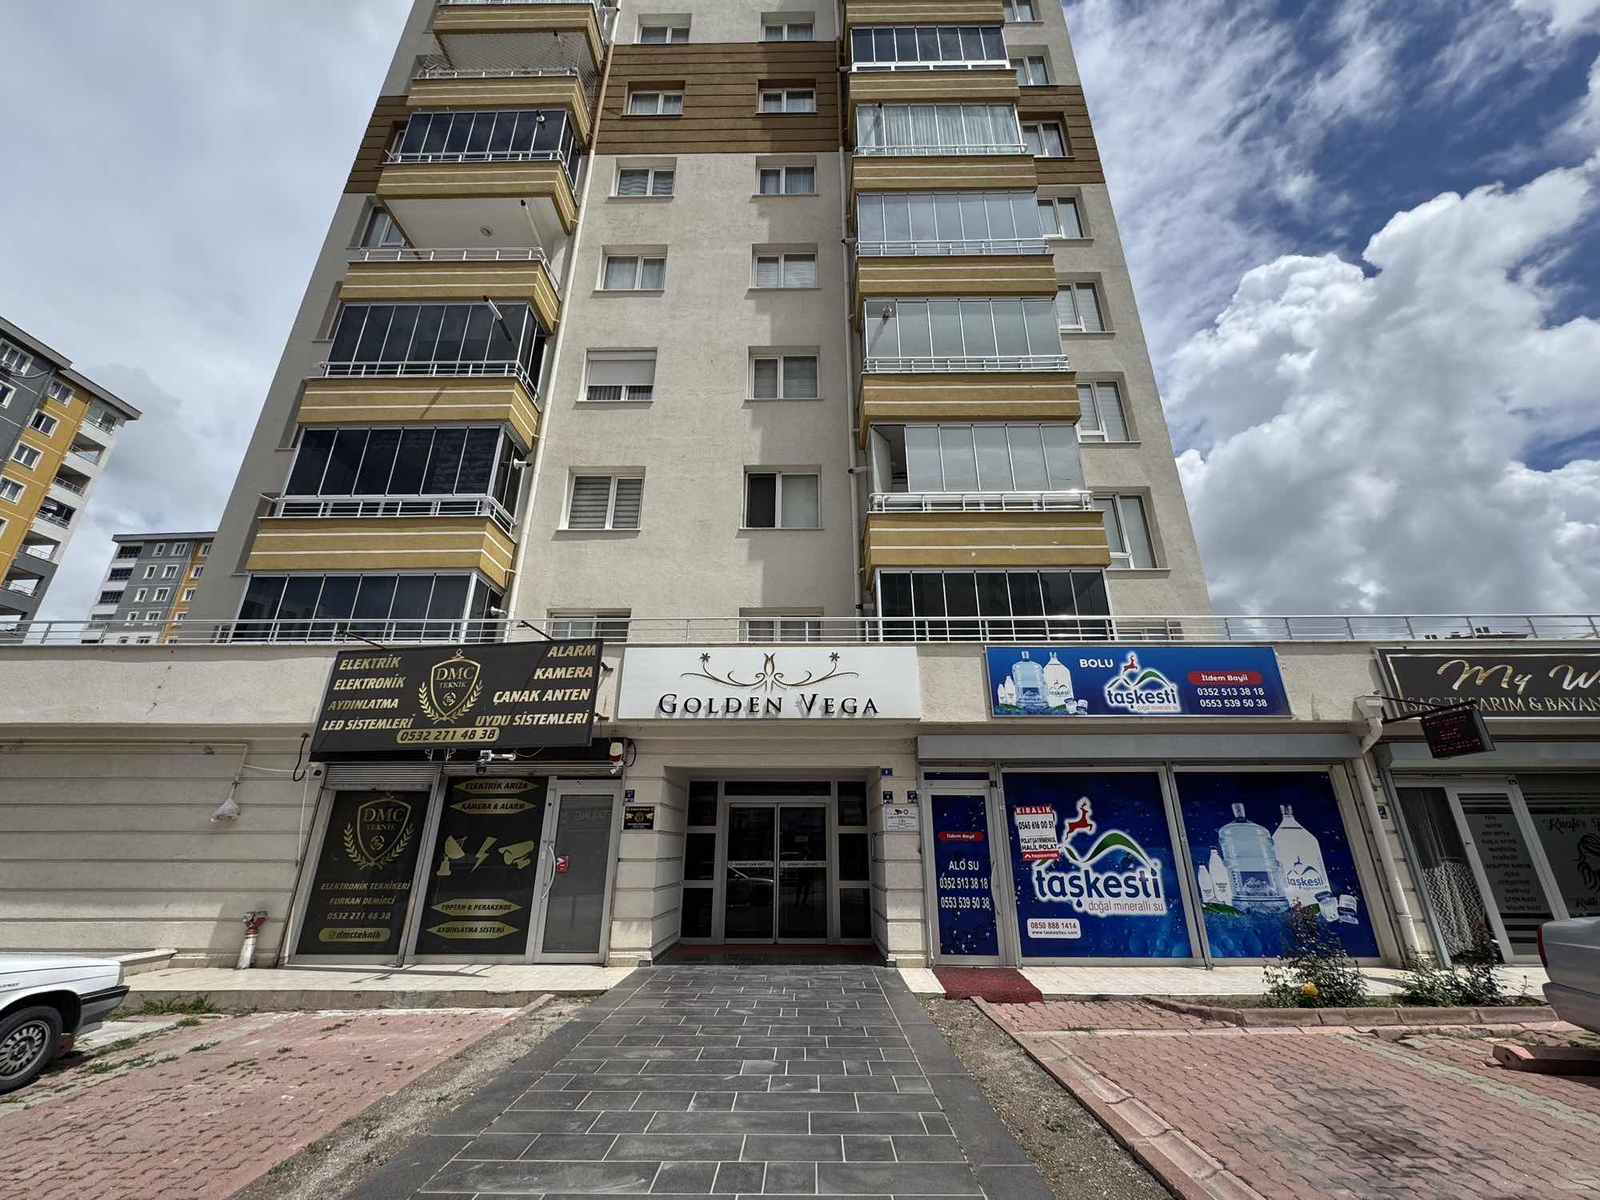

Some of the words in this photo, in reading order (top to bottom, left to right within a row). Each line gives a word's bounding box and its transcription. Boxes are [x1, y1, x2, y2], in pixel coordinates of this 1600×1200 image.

[547, 644, 597, 657] ALARM
[339, 654, 402, 671] ELEKTRİK
[1080, 659, 1114, 668] BOLU
[434, 666, 475, 681] DMC
[533, 666, 594, 679] KAMERA
[1548, 664, 1600, 691] W
[333, 674, 407, 690] ELEKTRONİK
[493, 690, 540, 705] ÇANAK
[542, 688, 591, 702] ANTEN
[1197, 687, 1219, 696] 0352
[1221, 687, 1238, 696] 513
[1239, 688, 1251, 696] 38
[1255, 688, 1264, 696] 18
[327, 698, 399, 711] AYDINLATMA
[658, 694, 783, 714] GOLDEN
[800, 694, 879, 714] VEGA
[1200, 699, 1222, 708] 0553
[1224, 699, 1241, 708] 539
[1242, 699, 1254, 708] 50
[1256, 699, 1267, 708] 38
[1529, 697, 1544, 711] &
[321, 719, 346, 731] LED
[347, 714, 416, 731] SİSTEMLERİ
[475, 714, 510, 727] UYDU
[512, 709, 590, 727] SİSTEMLERİ
[400, 730, 430, 742] 0532
[433, 730, 457, 742] 271
[460, 729, 477, 741] 48
[479, 729, 497, 741] 38
[465, 780, 503, 790] ELEKTRİK
[504, 782, 529, 790] ARIZA
[461, 802, 491, 810] KAMERA
[500, 802, 525, 810] ALARM
[1016, 806, 1051, 814] KIRALIK
[363, 807, 405, 822] DMC
[967, 860, 979, 871] SU
[320, 880, 367, 890] ELEKTRONİK
[369, 880, 411, 890] TEKNİKERİ
[939, 877, 955, 889] 0352
[956, 877, 969, 889] 513
[970, 877, 979, 889] 38
[980, 877, 988, 889] 18
[329, 897, 362, 905] FURKAN
[940, 897, 957, 909] 0553
[958, 897, 970, 909] 539
[972, 897, 981, 909] 50
[982, 897, 990, 909] 38
[1089, 900, 1111, 914] doğal
[1114, 900, 1151, 912] mineralli
[1153, 903, 1164, 912] su
[326, 912, 348, 920] 0532
[349, 912, 365, 920] 271
[436, 926, 478, 934] AYDINLATMA
[479, 925, 505, 934] SİSTEMİ
